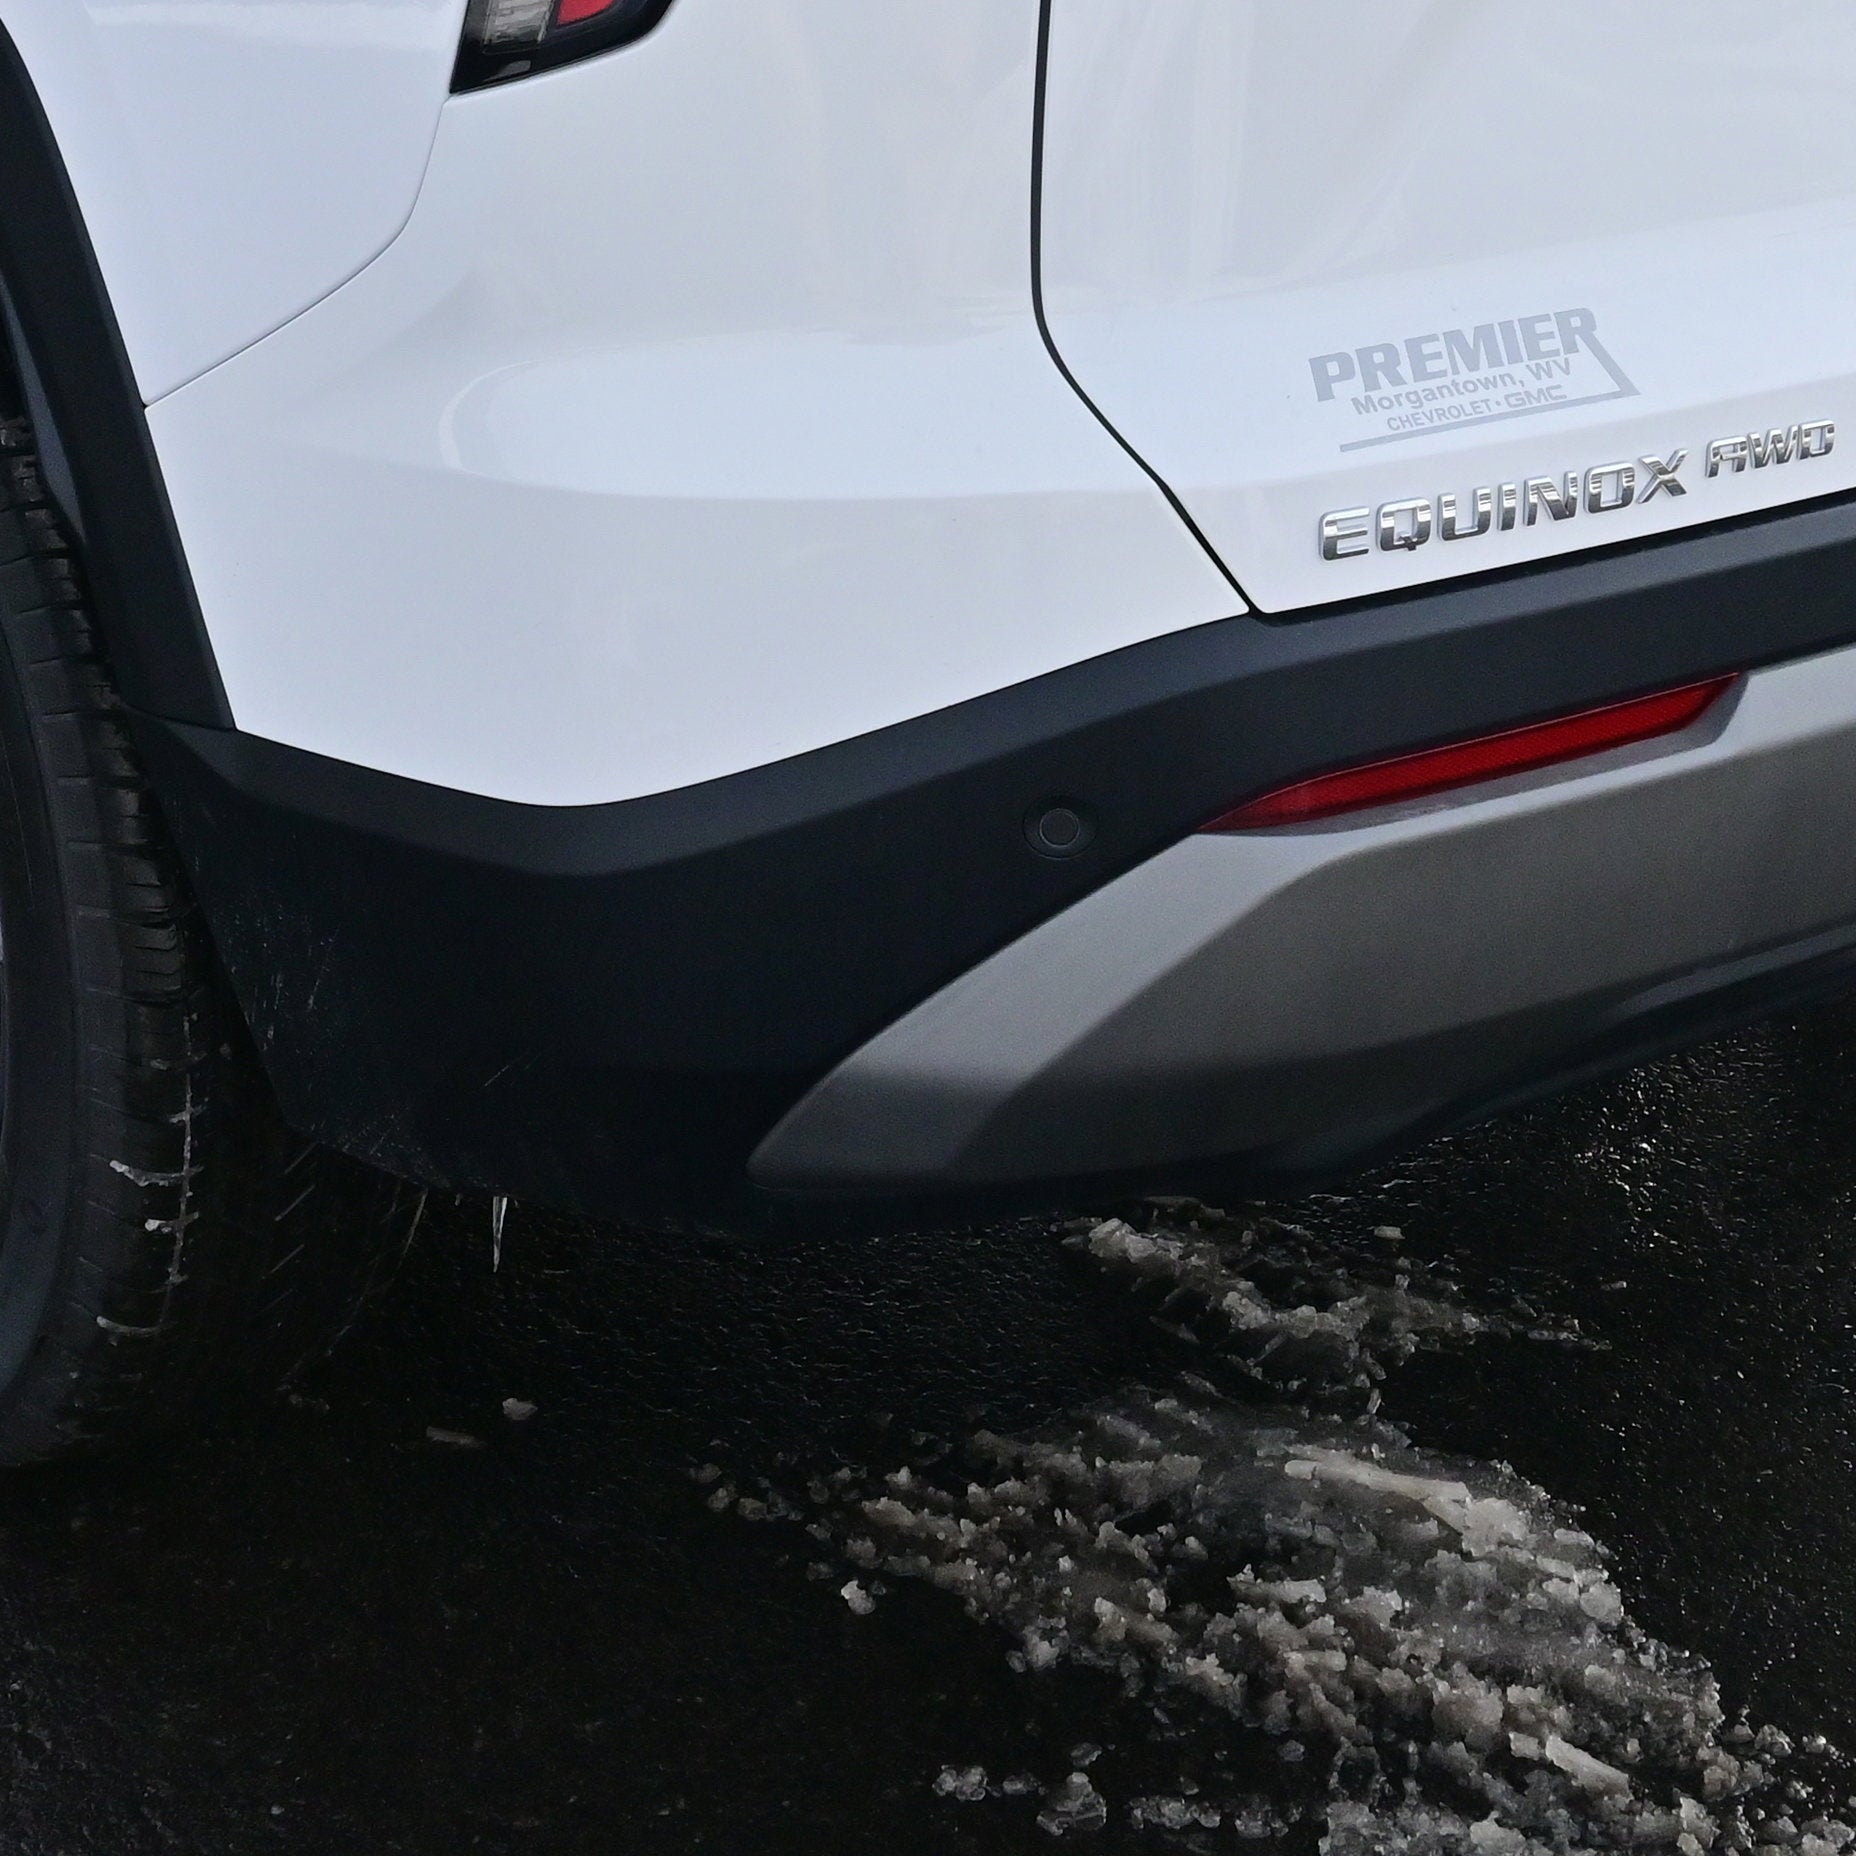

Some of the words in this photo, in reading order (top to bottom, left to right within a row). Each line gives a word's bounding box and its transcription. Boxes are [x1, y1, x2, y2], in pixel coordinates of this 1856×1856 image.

[1308, 307, 1598, 402] PREMIER
[1351, 370, 1526, 415] Morgantown,
[1526, 357, 1573, 381] WV
[1386, 398, 1494, 432] CHEVROLET
[1503, 384, 1568, 409] GMC
[1318, 446, 1689, 562] EQUINOX
[1705, 418, 1836, 478] AWD
